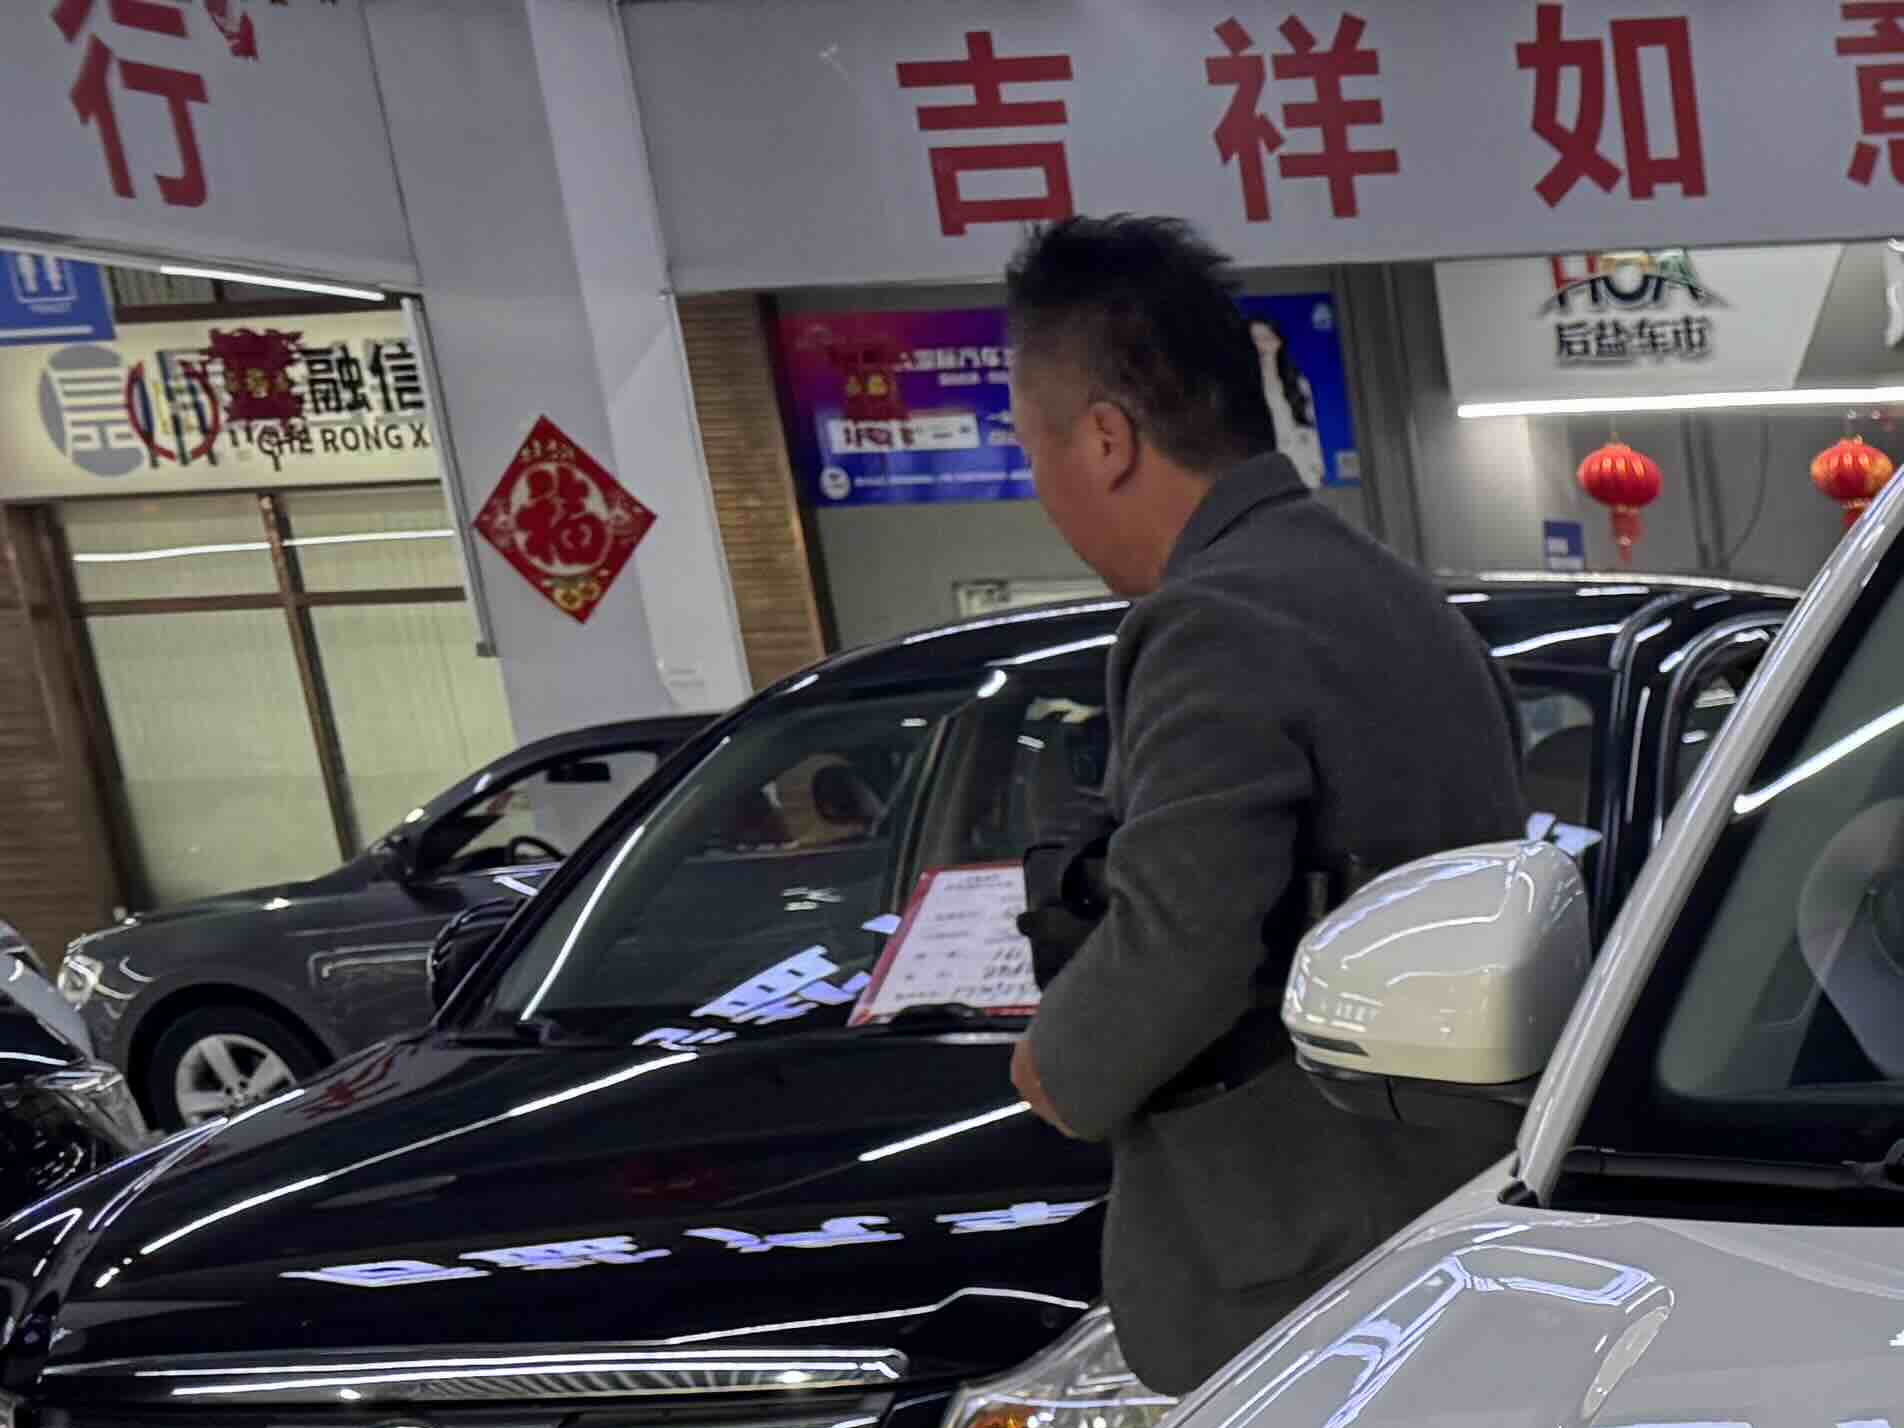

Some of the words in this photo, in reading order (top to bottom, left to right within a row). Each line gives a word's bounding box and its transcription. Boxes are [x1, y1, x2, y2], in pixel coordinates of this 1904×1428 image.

[52, 0, 208, 207] 行
[1555, 315, 1712, 360] 后盐车市
[322, 424, 401, 454] RONG
